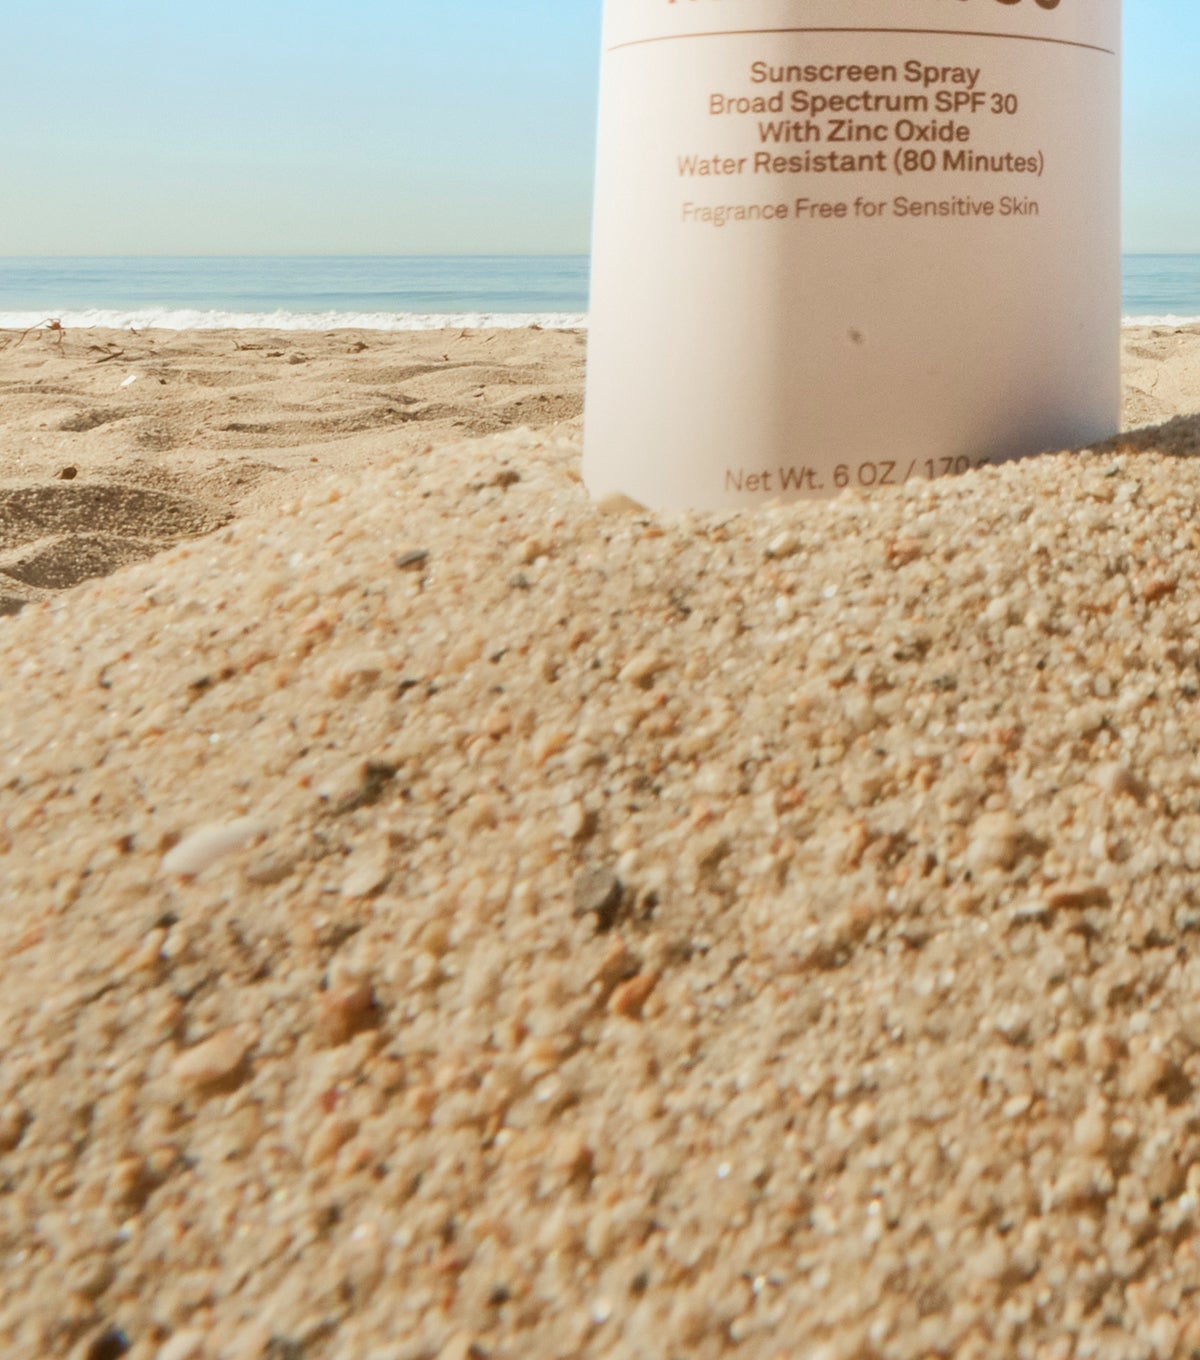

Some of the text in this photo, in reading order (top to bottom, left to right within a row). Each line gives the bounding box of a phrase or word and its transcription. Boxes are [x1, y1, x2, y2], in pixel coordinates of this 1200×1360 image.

[750, 60, 980, 89] Sunscreen Spray
[709, 90, 1018, 117] Broad Spectrum SPF 30
[758, 119, 970, 143] With Zinc Oxide
[677, 147, 1044, 177] Water Resistant (80 Minutes)
[682, 196, 1039, 227] Fragrance Free for Sensitive Skin
[725, 469, 771, 491] Net
[778, 466, 824, 490] Wt.
[833, 464, 849, 488] 6
[857, 461, 896, 487] OZ
